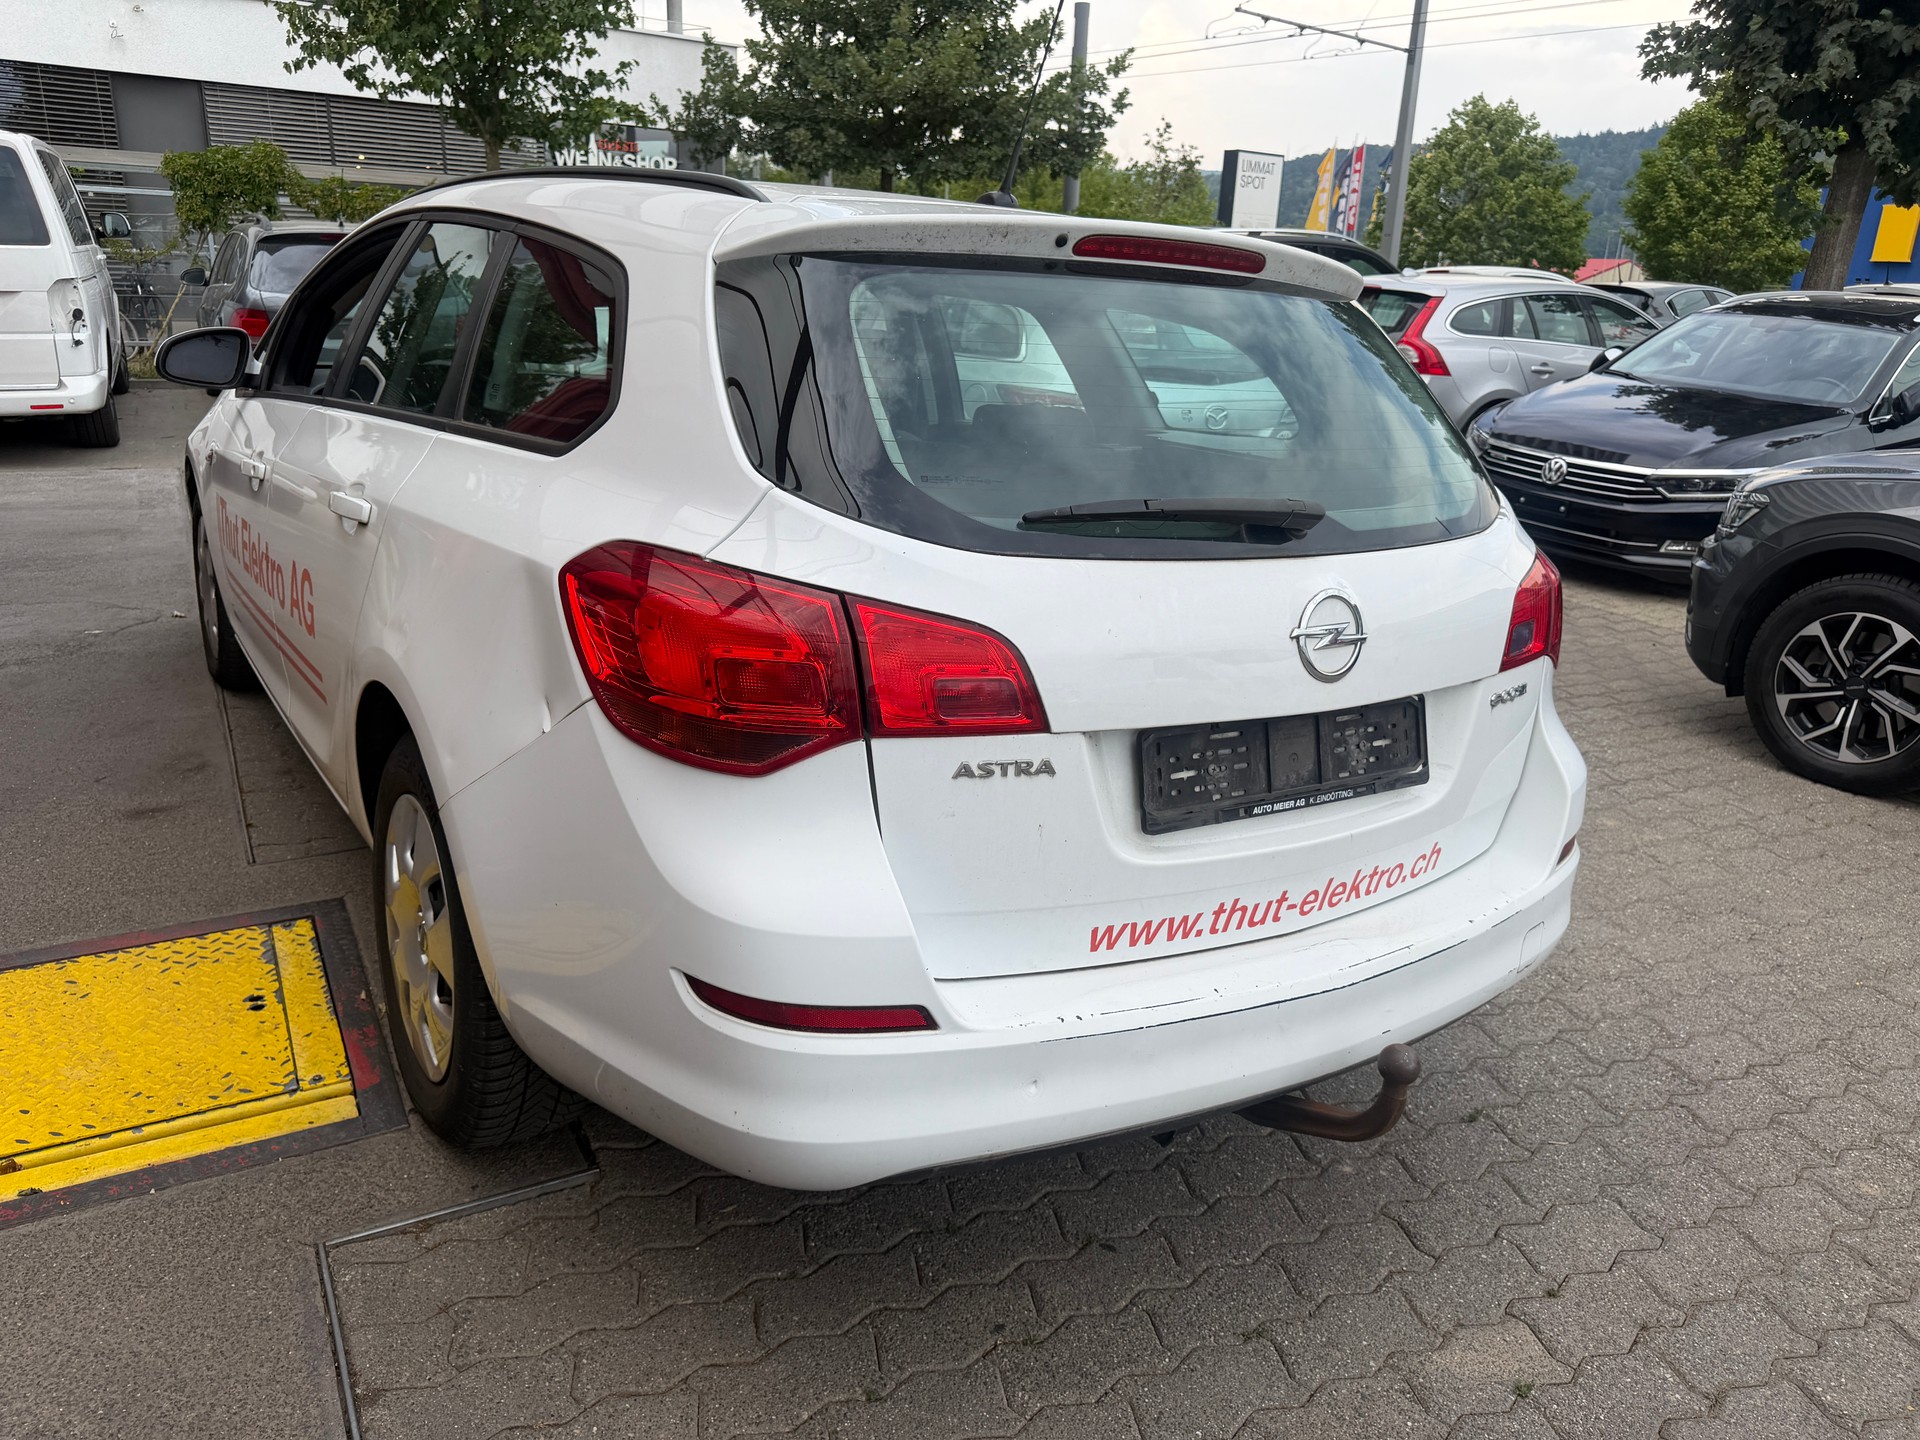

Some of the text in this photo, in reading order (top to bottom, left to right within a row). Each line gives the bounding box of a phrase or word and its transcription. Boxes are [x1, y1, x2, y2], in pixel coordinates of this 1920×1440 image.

[1241, 158, 1276, 175] LIMMAT
[1239, 174, 1267, 190] SPOT
[219, 496, 316, 639] Thut Elektro AG
[951, 758, 1056, 779] ASTRA
[1252, 804, 1272, 815] AUTO
[1273, 800, 1295, 811] MEIER
[1295, 798, 1306, 807] AG
[1089, 841, 1443, 953] www.thut-elektro.ch
